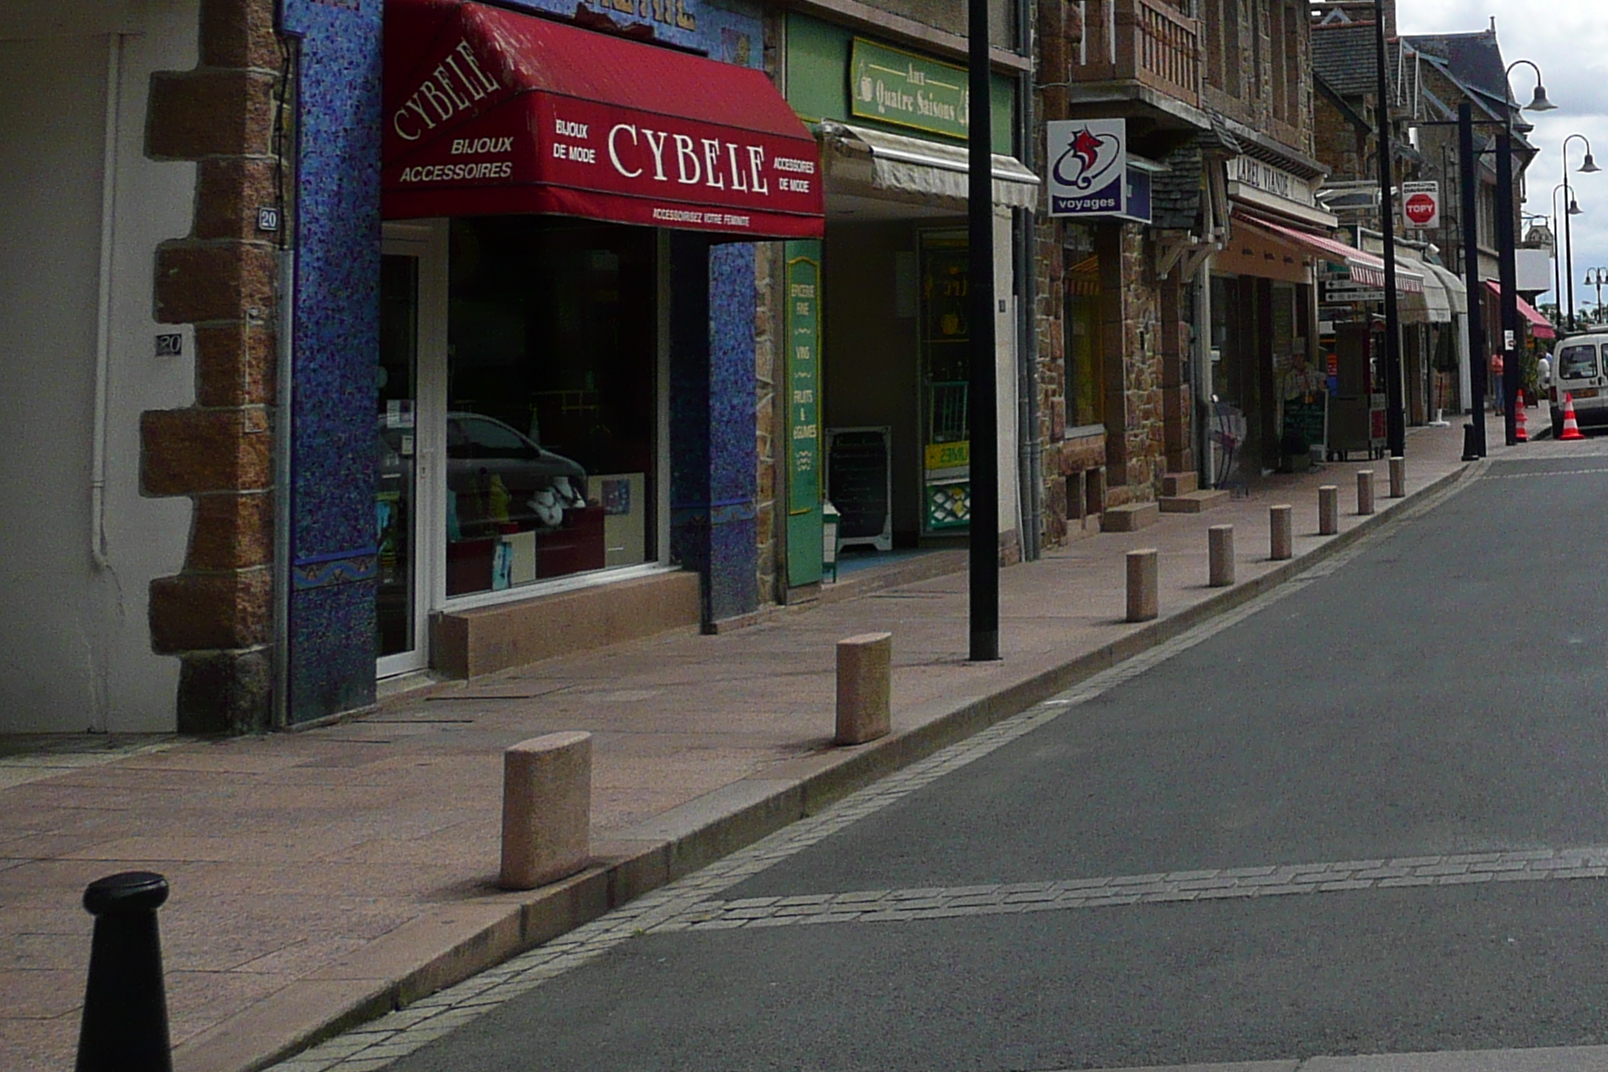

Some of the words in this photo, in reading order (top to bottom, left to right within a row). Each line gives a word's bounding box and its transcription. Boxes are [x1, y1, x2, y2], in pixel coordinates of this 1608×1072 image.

[907, 62, 925, 86] Aux
[393, 39, 501, 141] CYBELE
[876, 79, 914, 114] Quatre
[917, 90, 955, 121] Saisons
[555, 119, 588, 139] BIJOUX
[451, 136, 514, 155] BIJOUX
[553, 142, 567, 160] DE
[568, 144, 596, 166] MODE
[607, 123, 769, 196] CYBELE
[773, 155, 815, 175] ACCESSOIRES
[399, 161, 513, 183] ACCESSOIRES
[778, 176, 789, 192] DE
[790, 177, 809, 194] MODE
[1058, 198, 1116, 212] voyages
[1407, 204, 1433, 213] TOPY
[261, 211, 276, 227] 20
